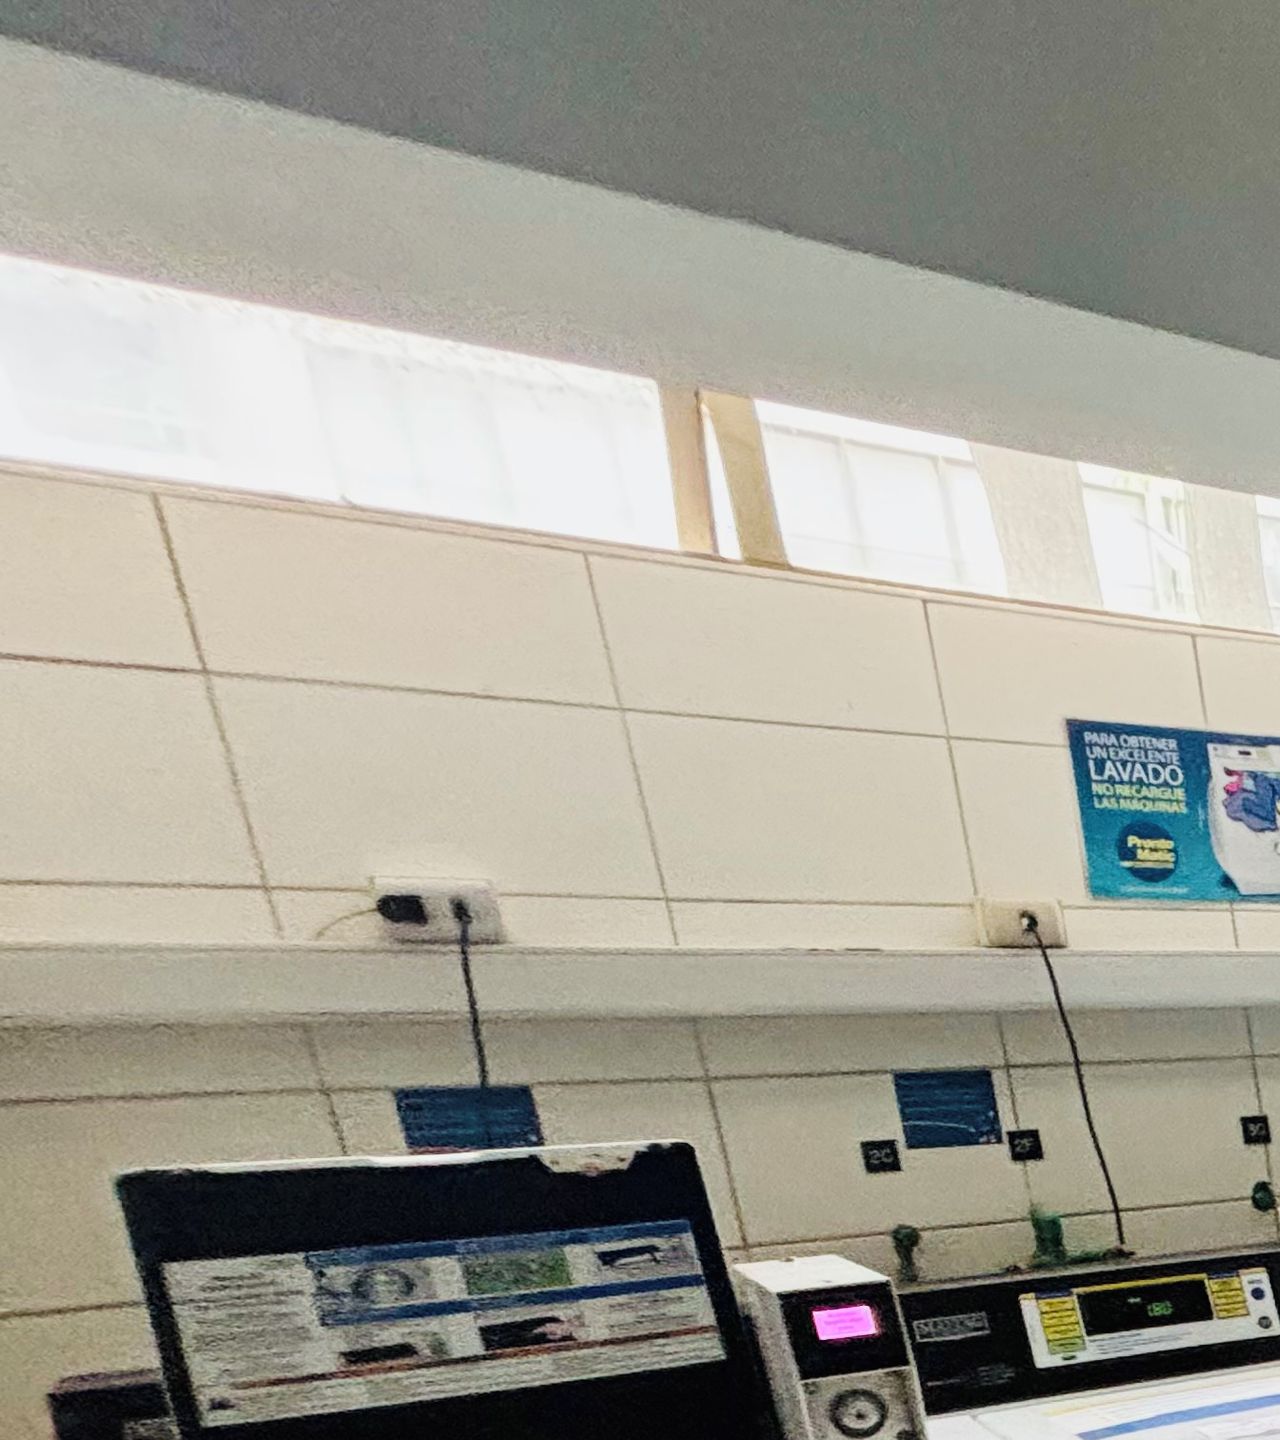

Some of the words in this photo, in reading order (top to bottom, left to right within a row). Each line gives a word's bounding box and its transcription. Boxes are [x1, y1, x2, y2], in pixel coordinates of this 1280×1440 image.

[1083, 731, 1119, 747] PARA
[1120, 734, 1178, 751] OBTENER
[1086, 746, 1108, 760] UN
[1109, 747, 1180, 766] EXCELENTE
[1088, 759, 1184, 786] LAVADO
[1092, 782, 1115, 796] NO
